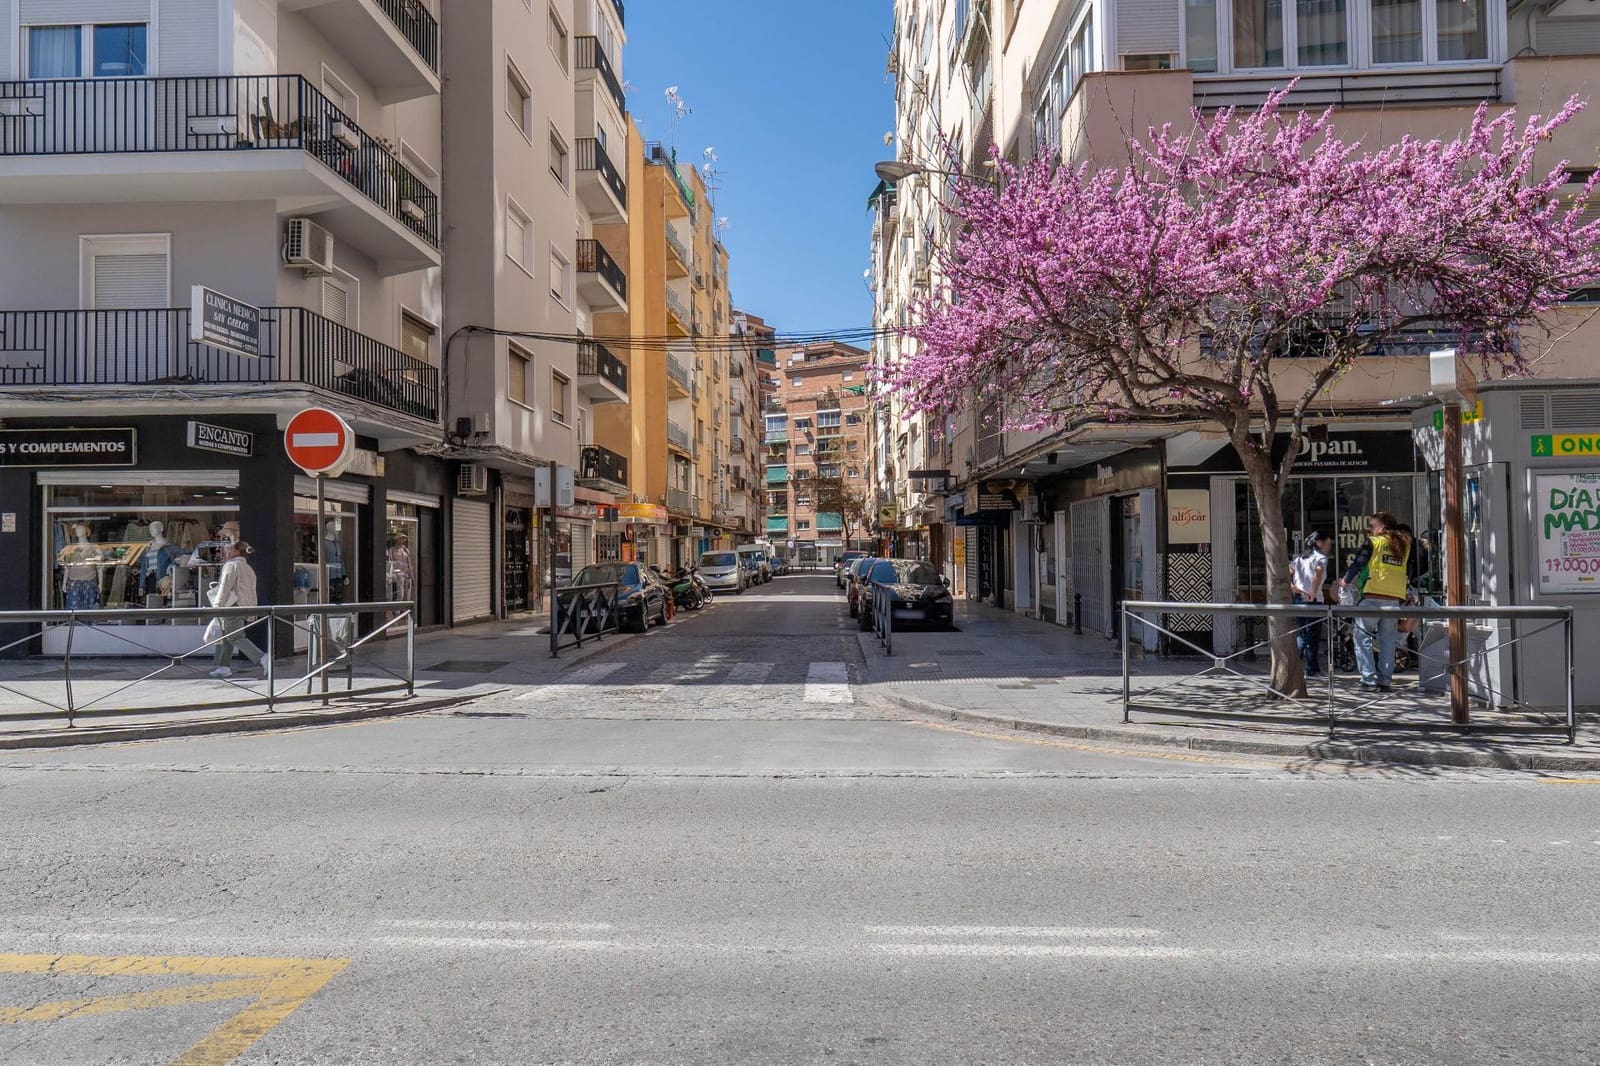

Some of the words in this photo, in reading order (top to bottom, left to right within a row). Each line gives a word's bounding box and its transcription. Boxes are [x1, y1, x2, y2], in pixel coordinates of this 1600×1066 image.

[199, 425, 249, 447] ENCANTO
[9, 443, 17, 453] Y
[20, 442, 126, 453] COMPLEMENTOS
